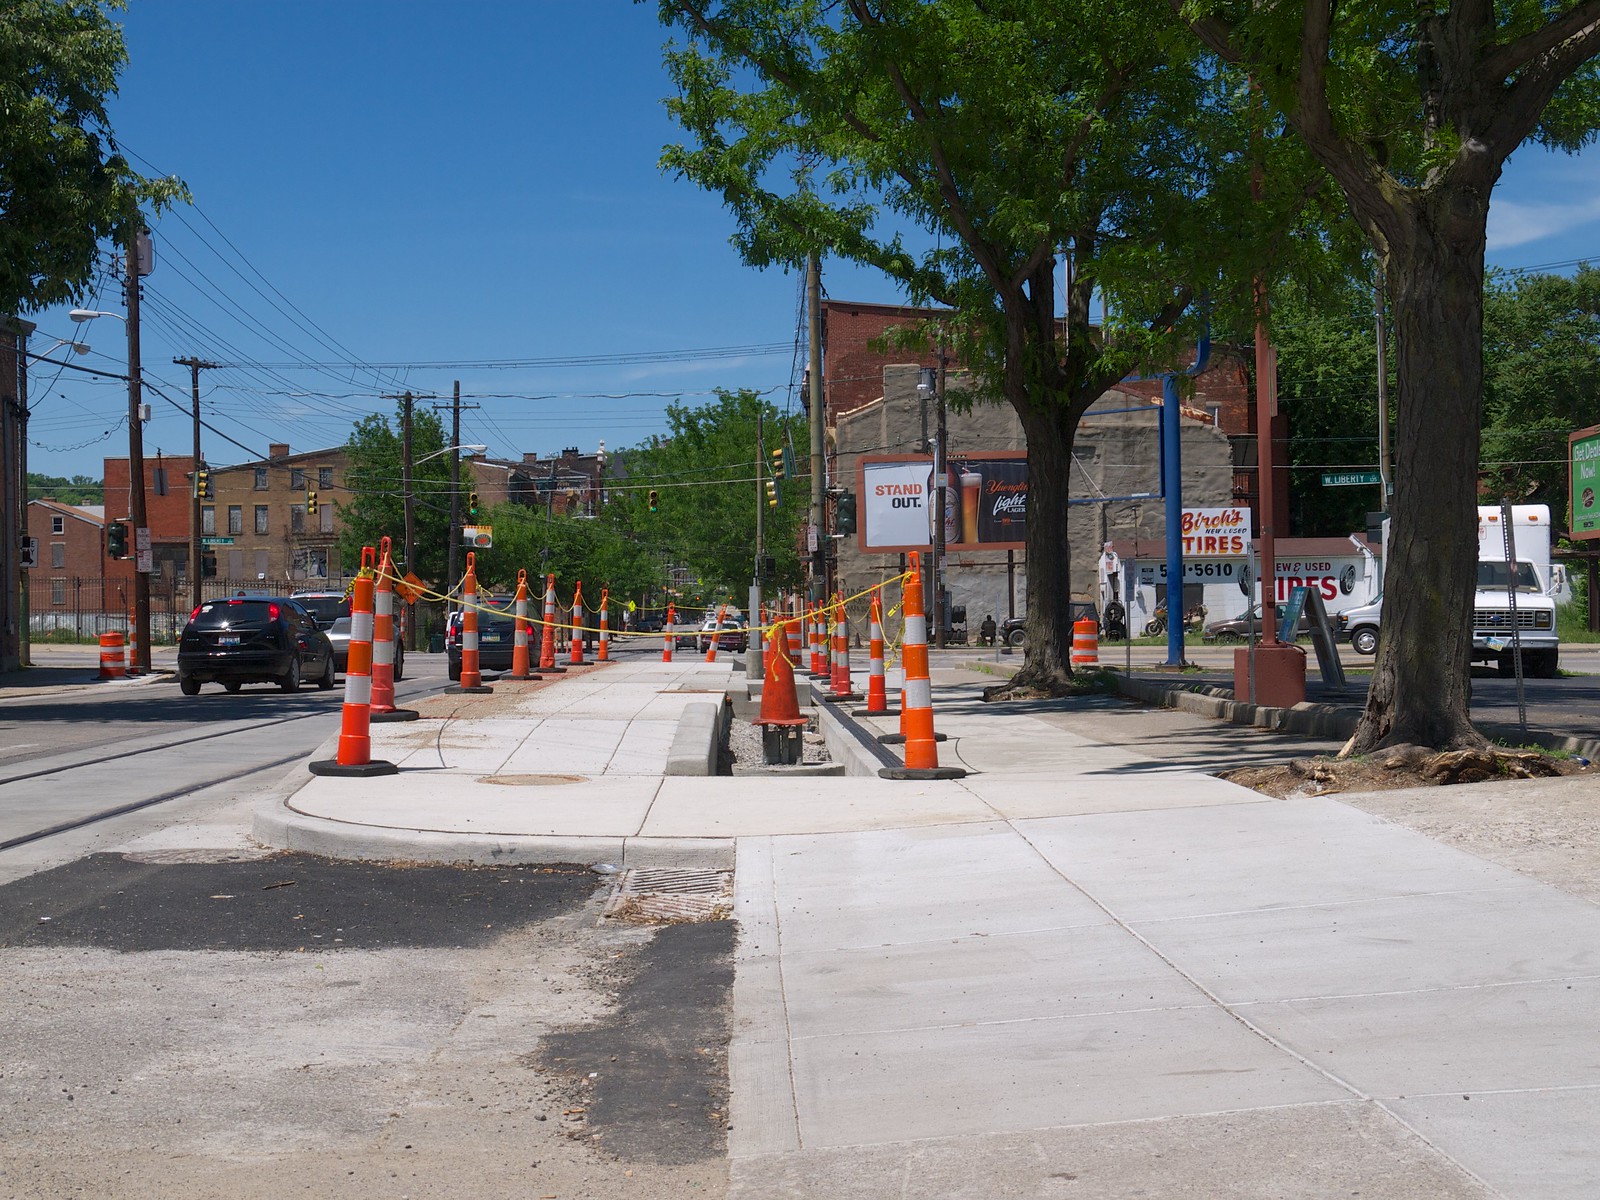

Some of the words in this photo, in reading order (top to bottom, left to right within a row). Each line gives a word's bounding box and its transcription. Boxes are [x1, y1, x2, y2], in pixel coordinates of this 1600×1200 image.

[1324, 476, 1333, 484] W.
[1334, 474, 1365, 484] LIBERTY
[875, 483, 922, 496] STAND
[891, 497, 922, 509] OUT.
[992, 492, 1027, 516] Light
[1182, 508, 1244, 536] Birch's
[1182, 535, 1244, 554] TIRES
[1276, 563, 1292, 572] EW
[1305, 562, 1332, 572] USED
[1257, 575, 1338, 601] IRS
